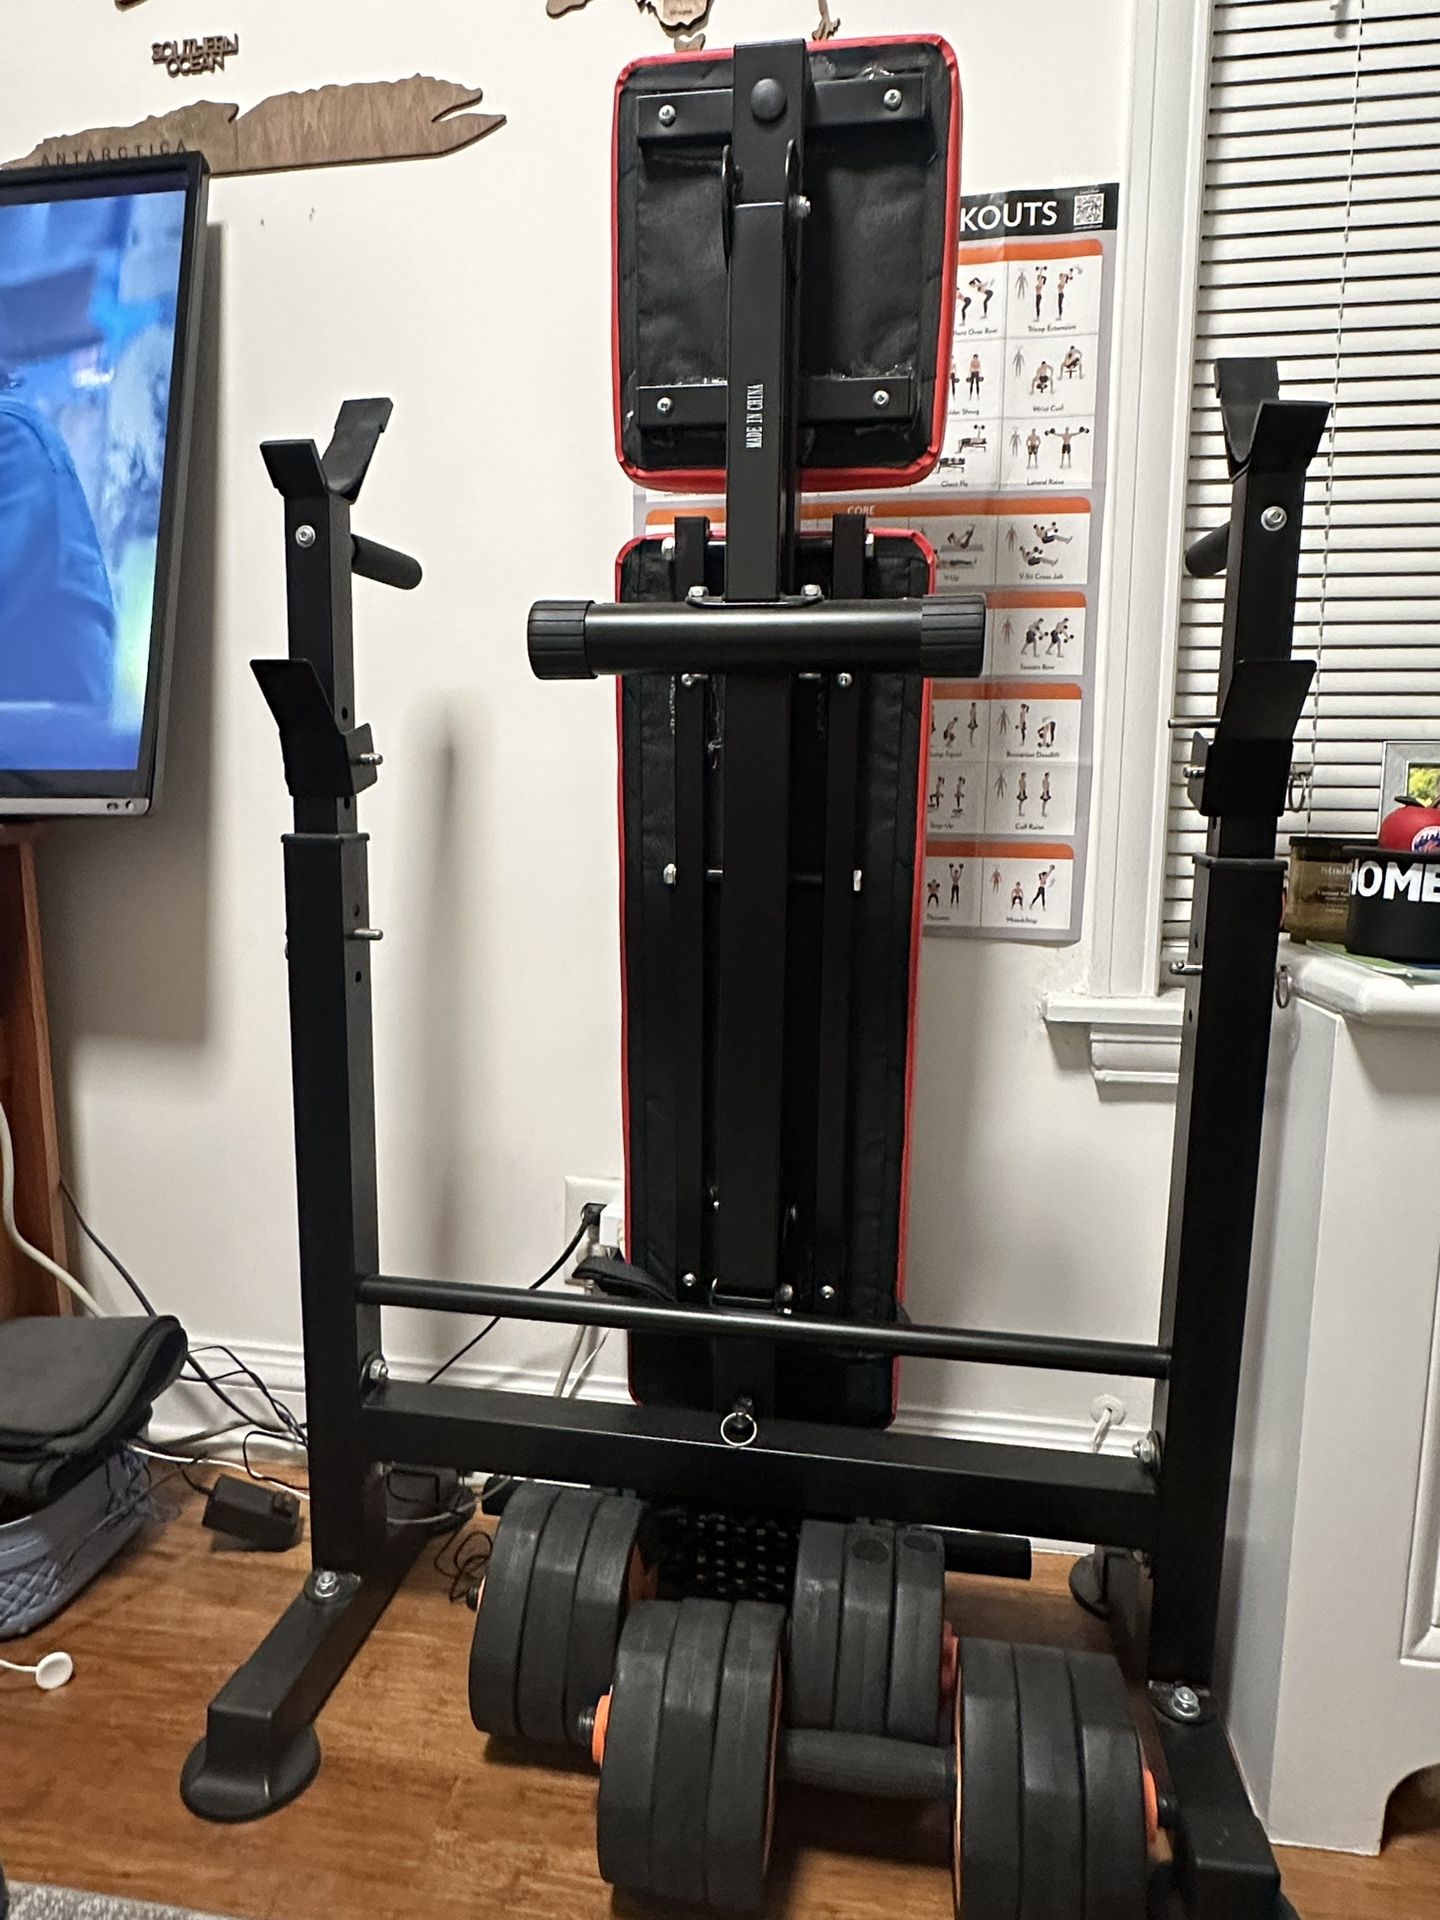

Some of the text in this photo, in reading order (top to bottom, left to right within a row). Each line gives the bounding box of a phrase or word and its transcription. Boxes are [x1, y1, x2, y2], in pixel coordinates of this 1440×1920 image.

[151, 33, 239, 64] SOUTHERN
[166, 51, 225, 78] OCEAN
[41, 139, 187, 167] ANTARCTICA
[960, 201, 1058, 232] KOUTS
[745, 384, 764, 449] MADE IN CHINA
[847, 504, 876, 516] CORE
